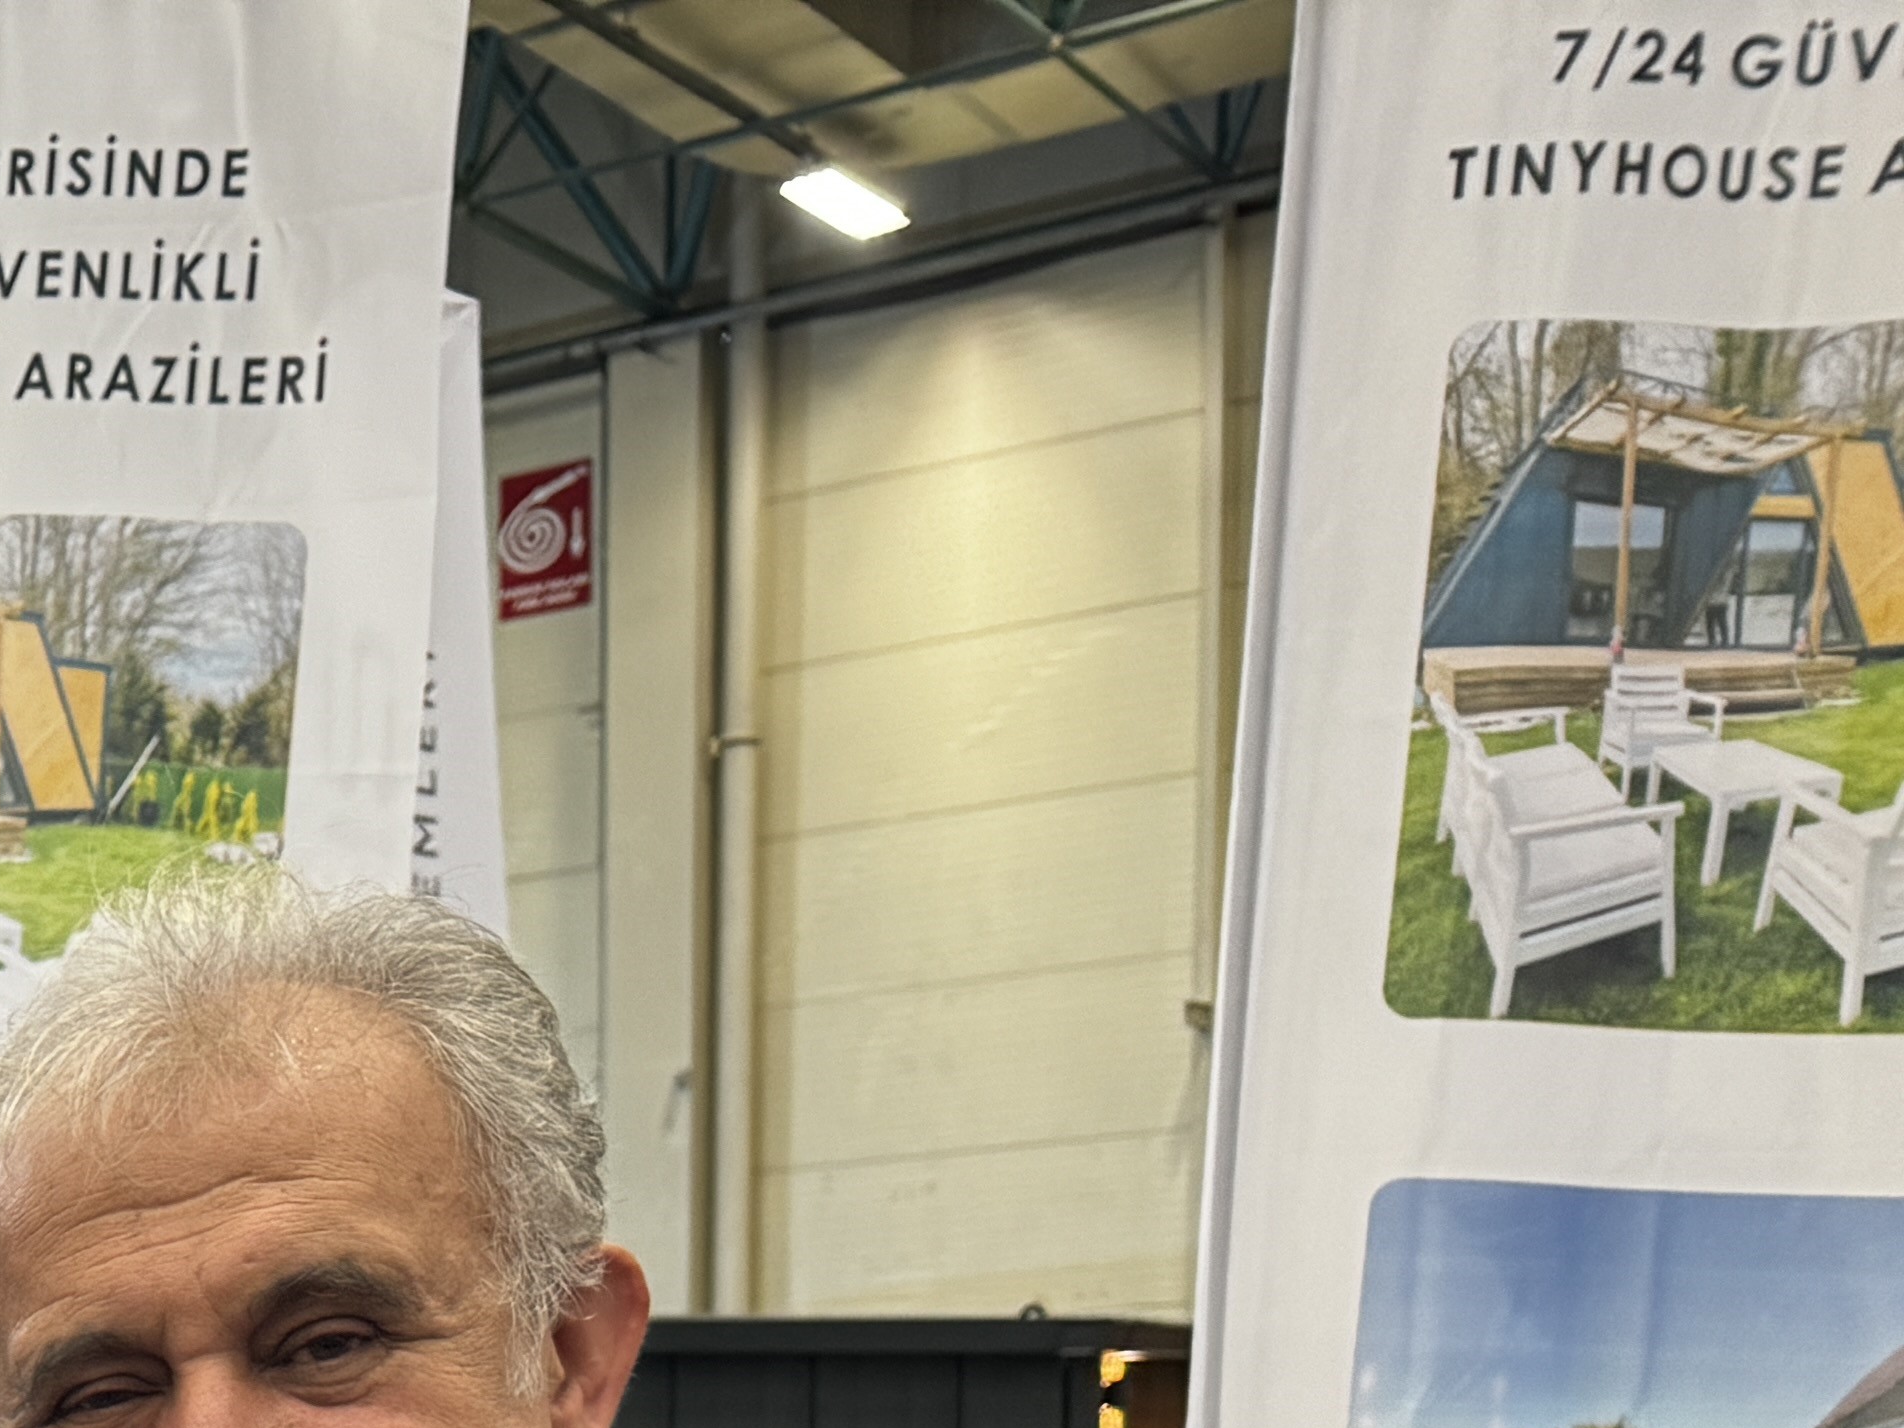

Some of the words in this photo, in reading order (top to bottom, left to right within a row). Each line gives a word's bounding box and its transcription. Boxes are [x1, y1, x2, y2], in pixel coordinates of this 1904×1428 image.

[1552, 25, 1706, 92] 7/24
[1729, 18, 1904, 90] GÜV
[1447, 139, 1847, 204] TINYHOUSE
[13, 335, 329, 407] ARAZİLERİ
